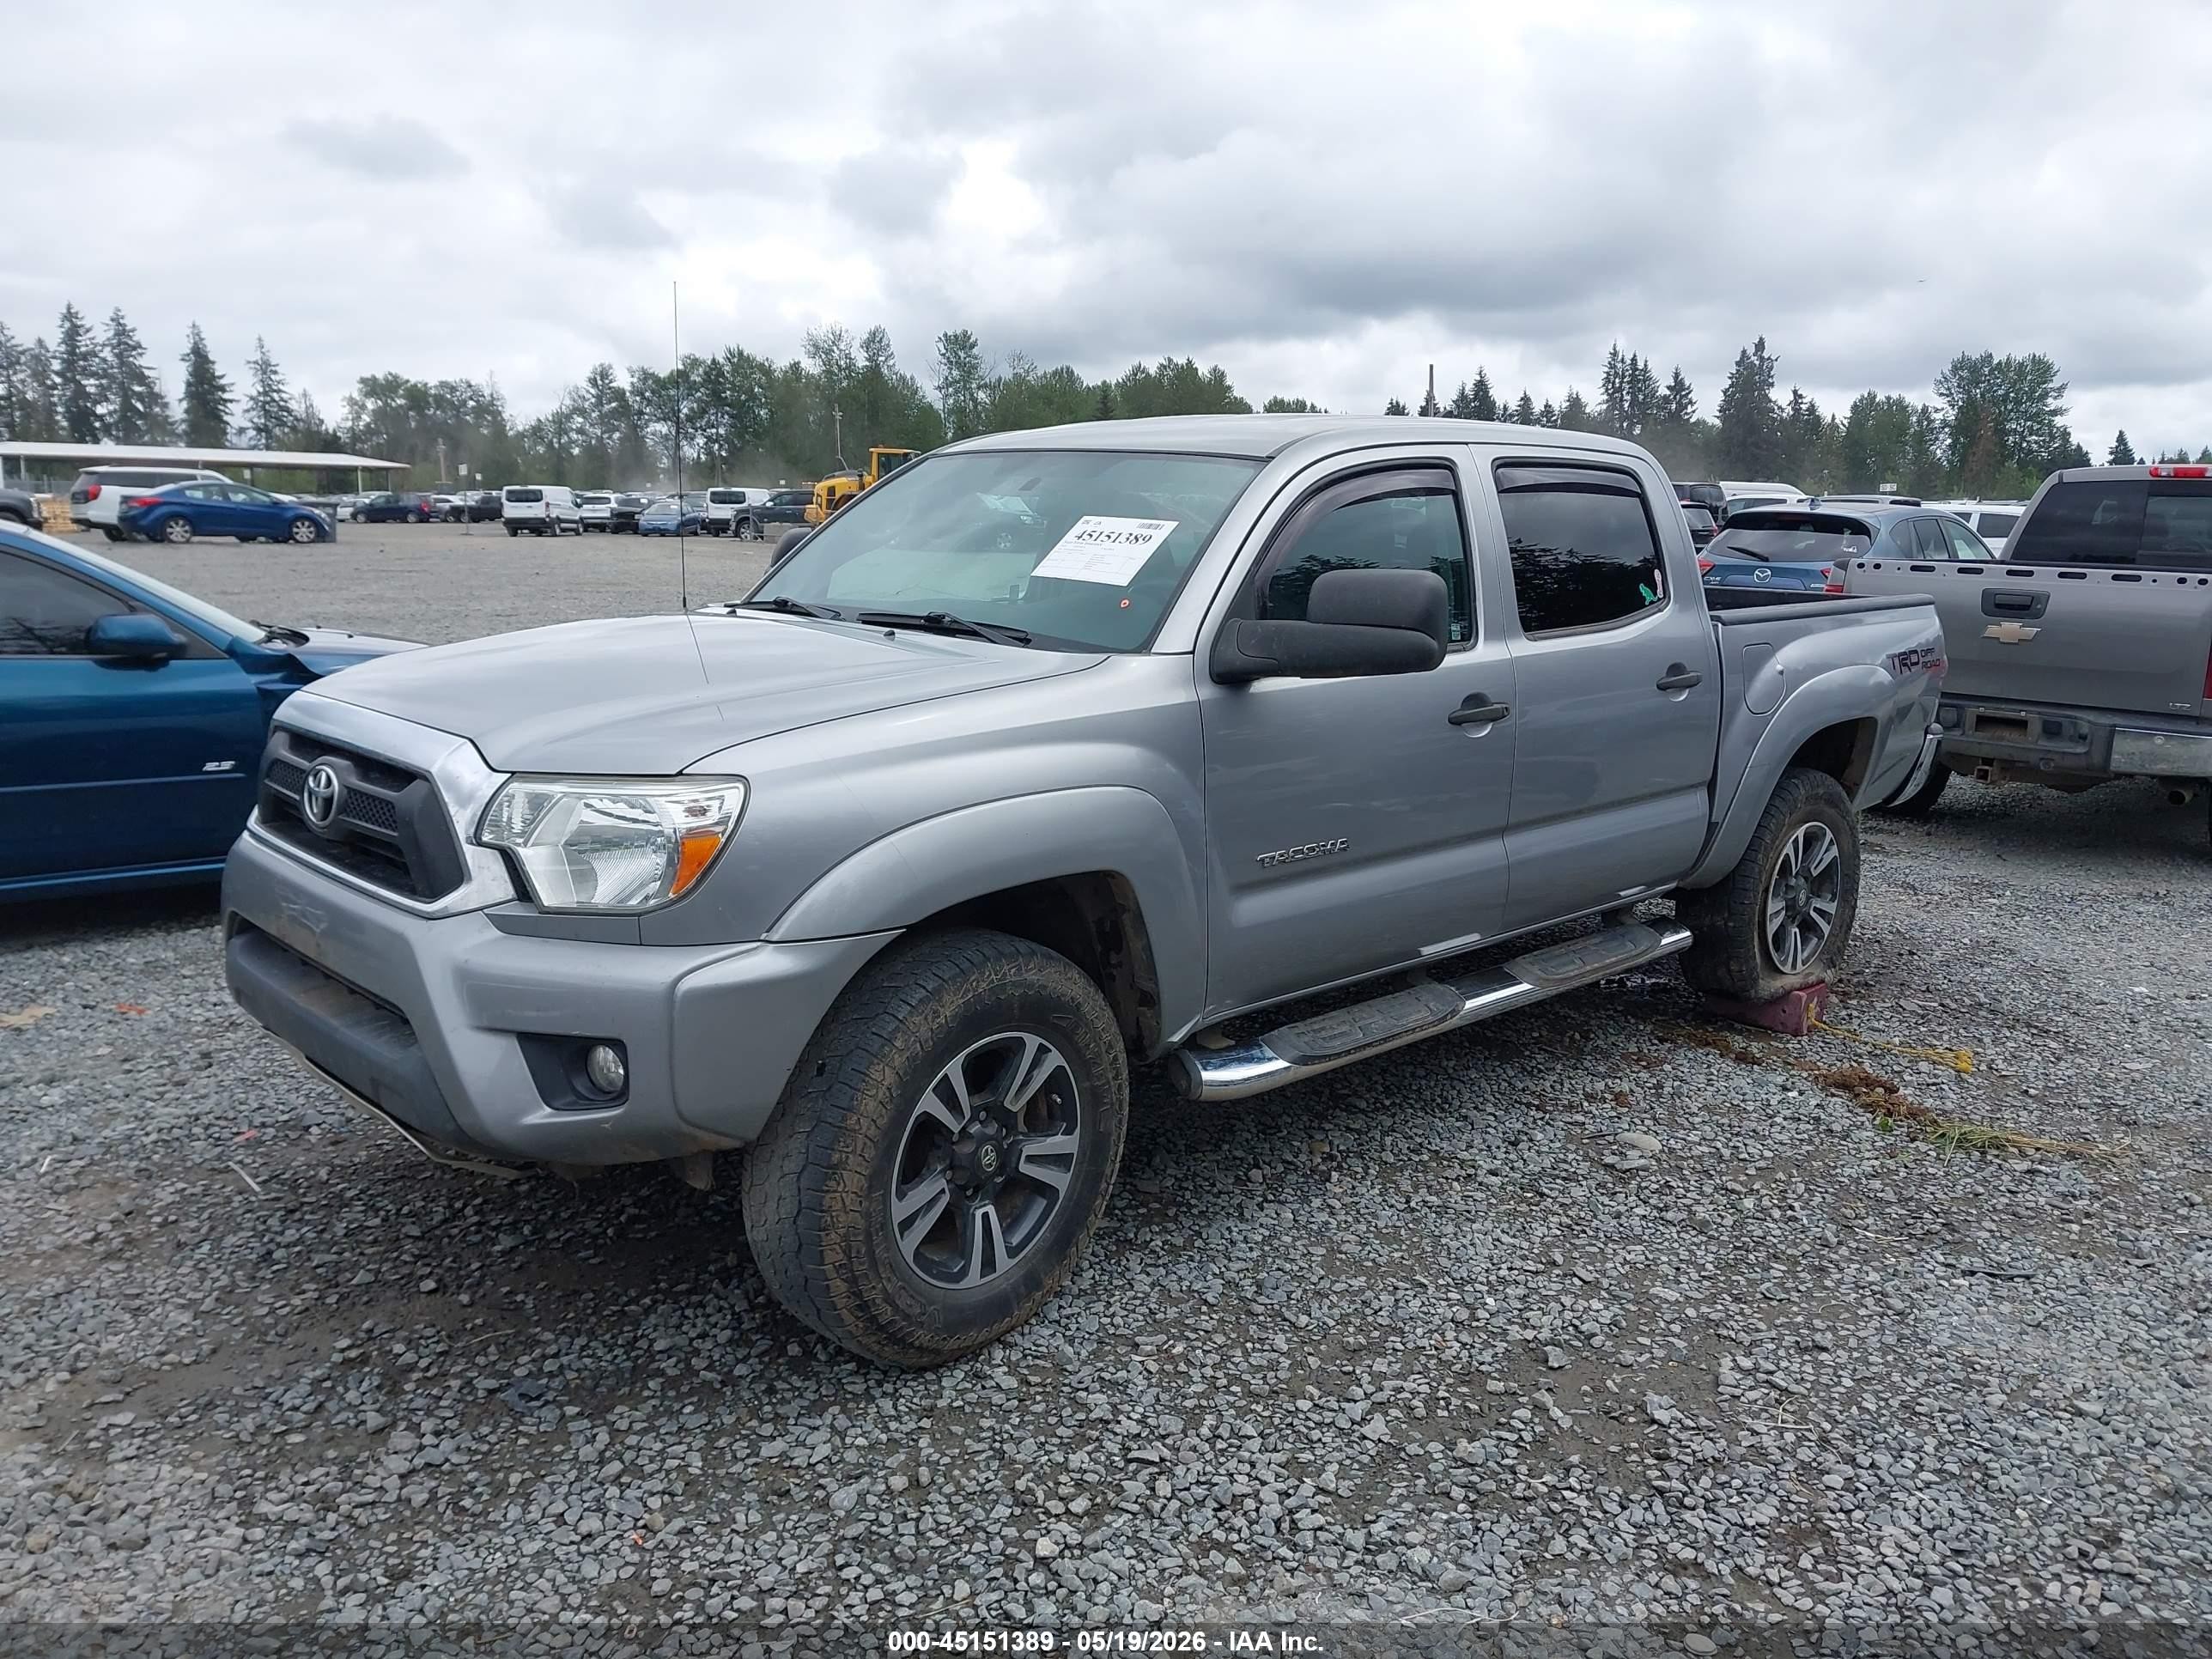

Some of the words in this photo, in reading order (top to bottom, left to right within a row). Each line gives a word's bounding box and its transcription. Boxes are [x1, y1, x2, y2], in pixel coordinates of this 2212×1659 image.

[1073, 529, 1153, 545] 45151389
[1920, 647, 1936, 658] OFF
[1886, 649, 1920, 675] TRD
[1922, 659, 1941, 670] ROAD
[1256, 838, 1350, 867] TACOMA
